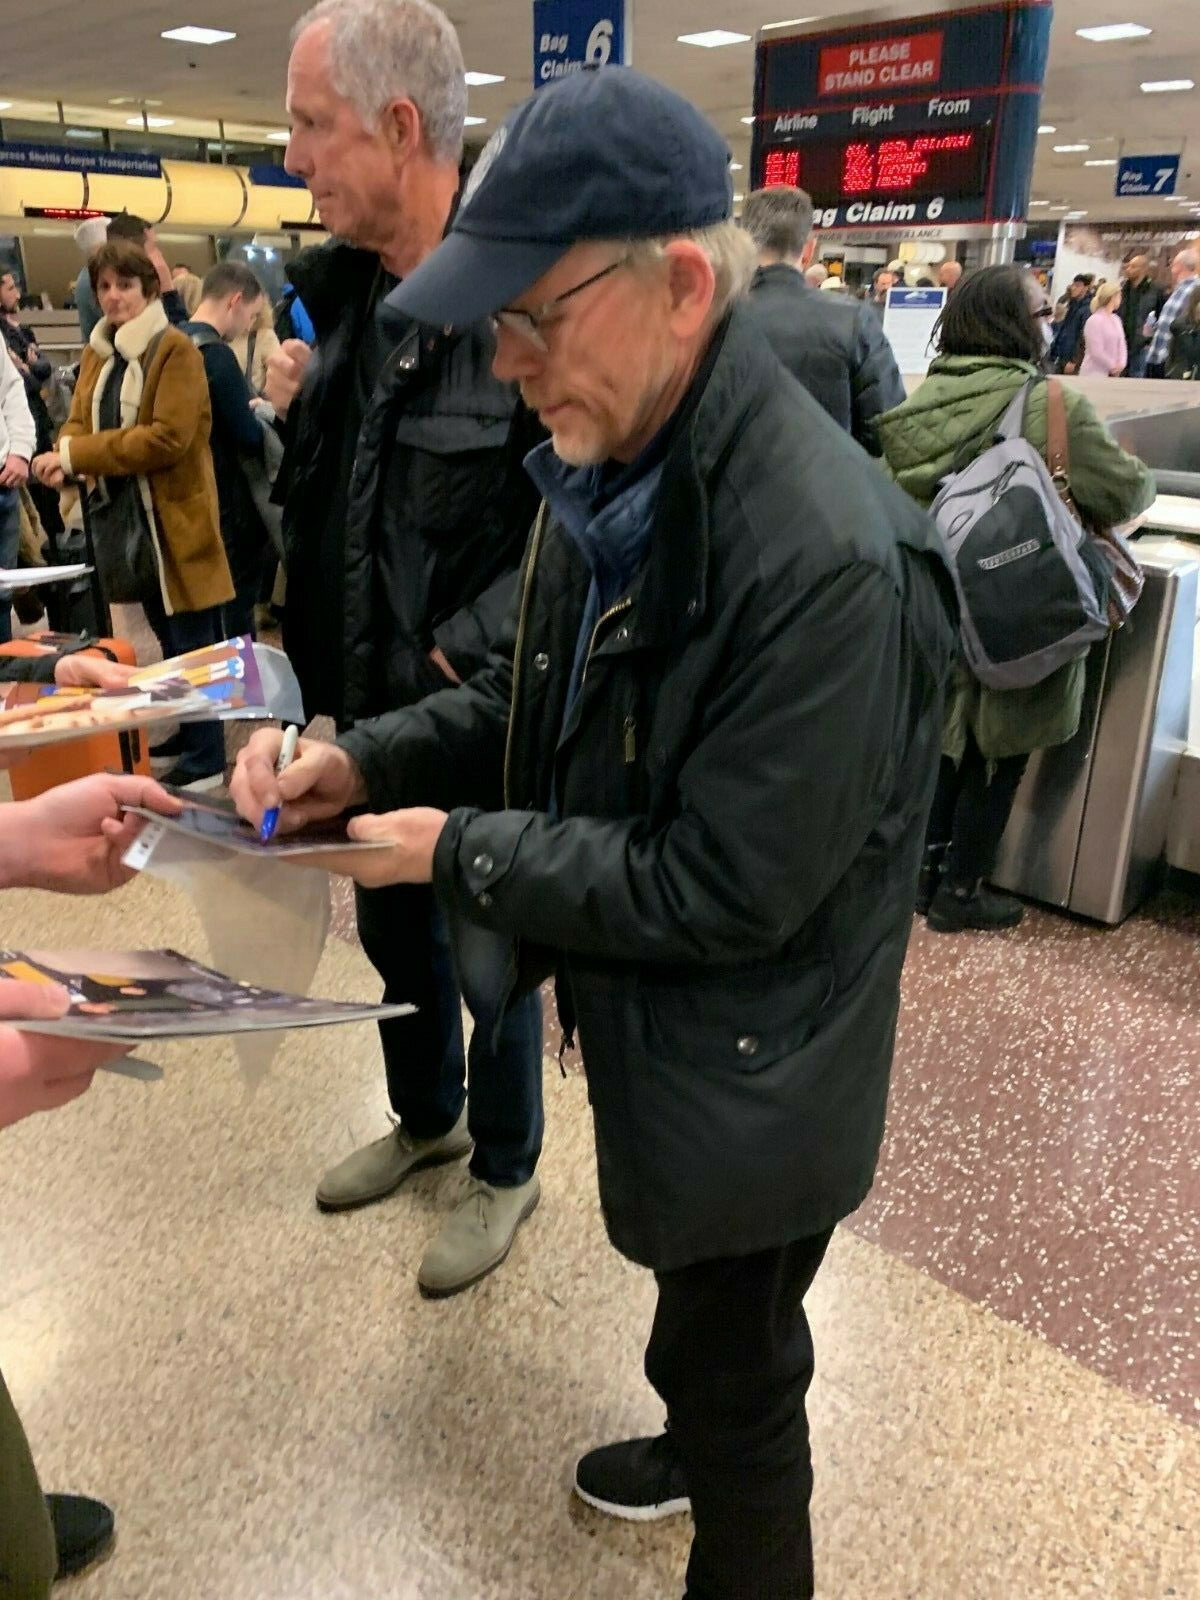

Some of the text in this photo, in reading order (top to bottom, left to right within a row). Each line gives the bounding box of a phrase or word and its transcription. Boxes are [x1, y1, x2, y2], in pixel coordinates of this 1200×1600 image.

[540, 34, 568, 53] Bag
[585, 19, 613, 66] 6
[849, 42, 910, 66] PLEASE
[541, 58, 583, 80] Claim
[825, 60, 934, 91] STAND CLEAR
[774, 97, 970, 133] Airline Flight From
[1152, 168, 1175, 192] 7
[812, 196, 945, 228] ag Claim 6
